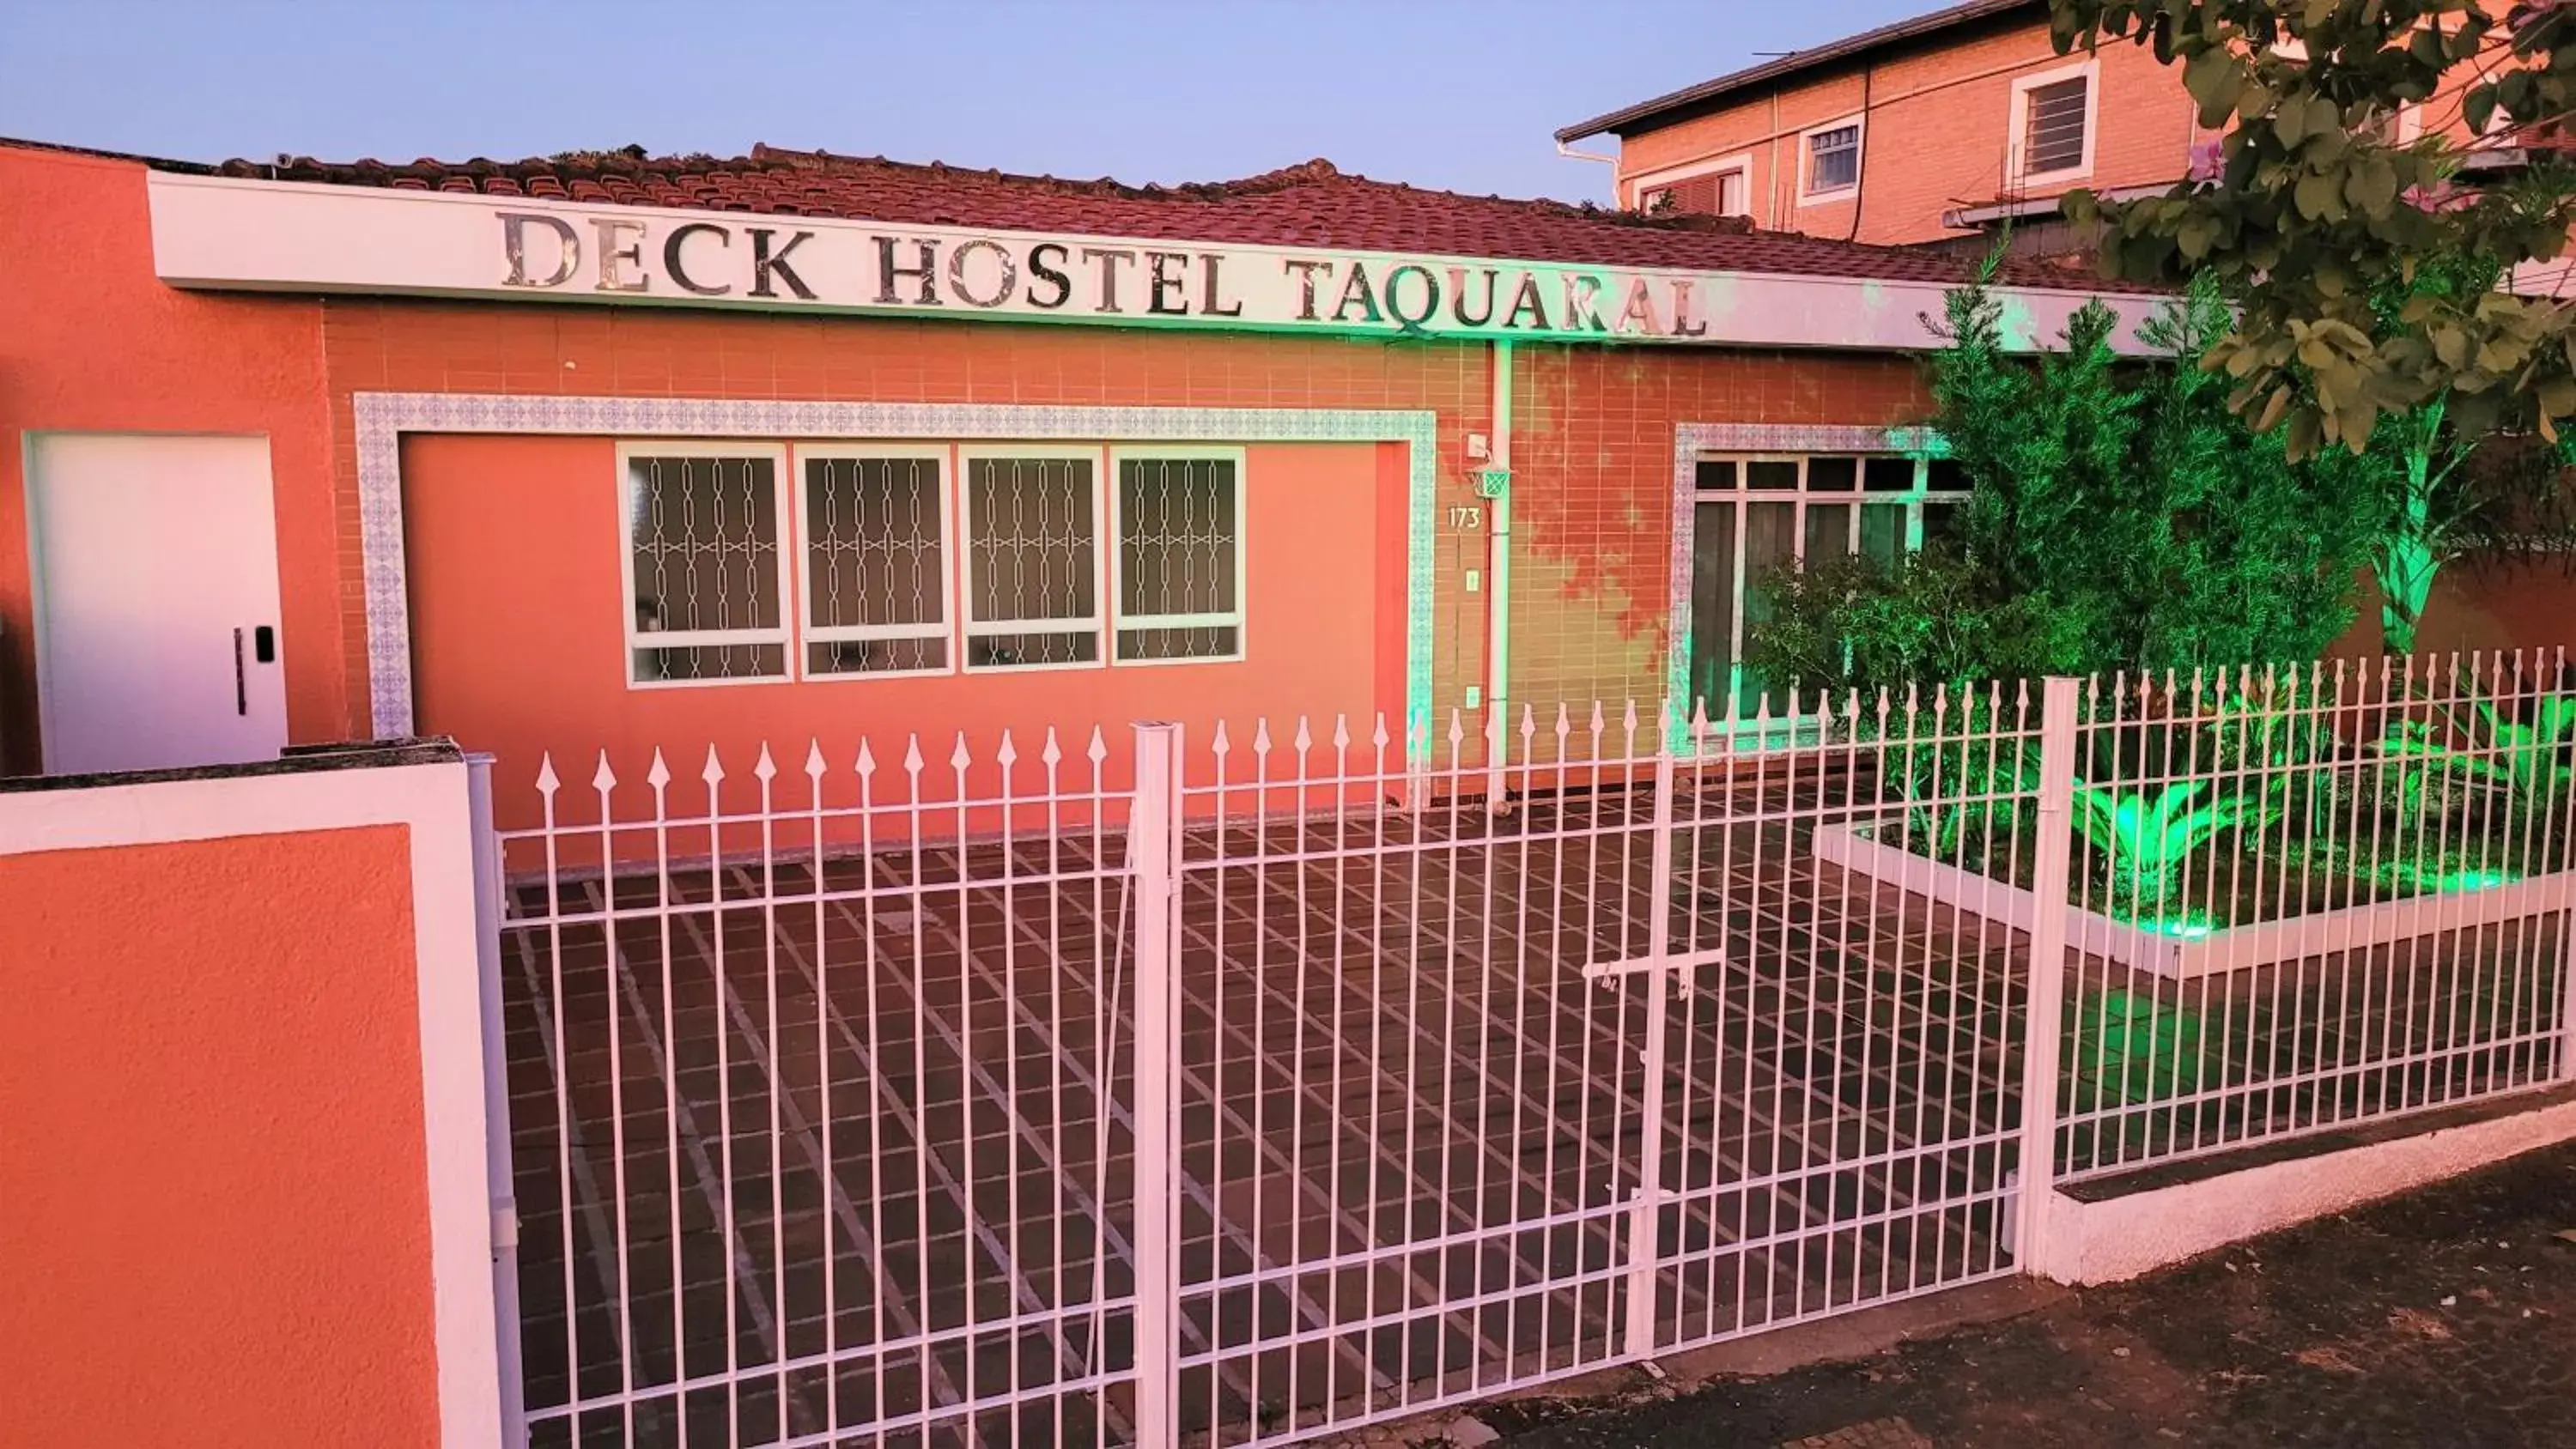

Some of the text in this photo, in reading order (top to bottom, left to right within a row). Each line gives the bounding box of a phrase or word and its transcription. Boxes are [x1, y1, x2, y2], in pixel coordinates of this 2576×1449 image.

[495, 211, 1707, 338] DECK HOSTEL TAQUARAL
[1449, 507, 1480, 529] 173
